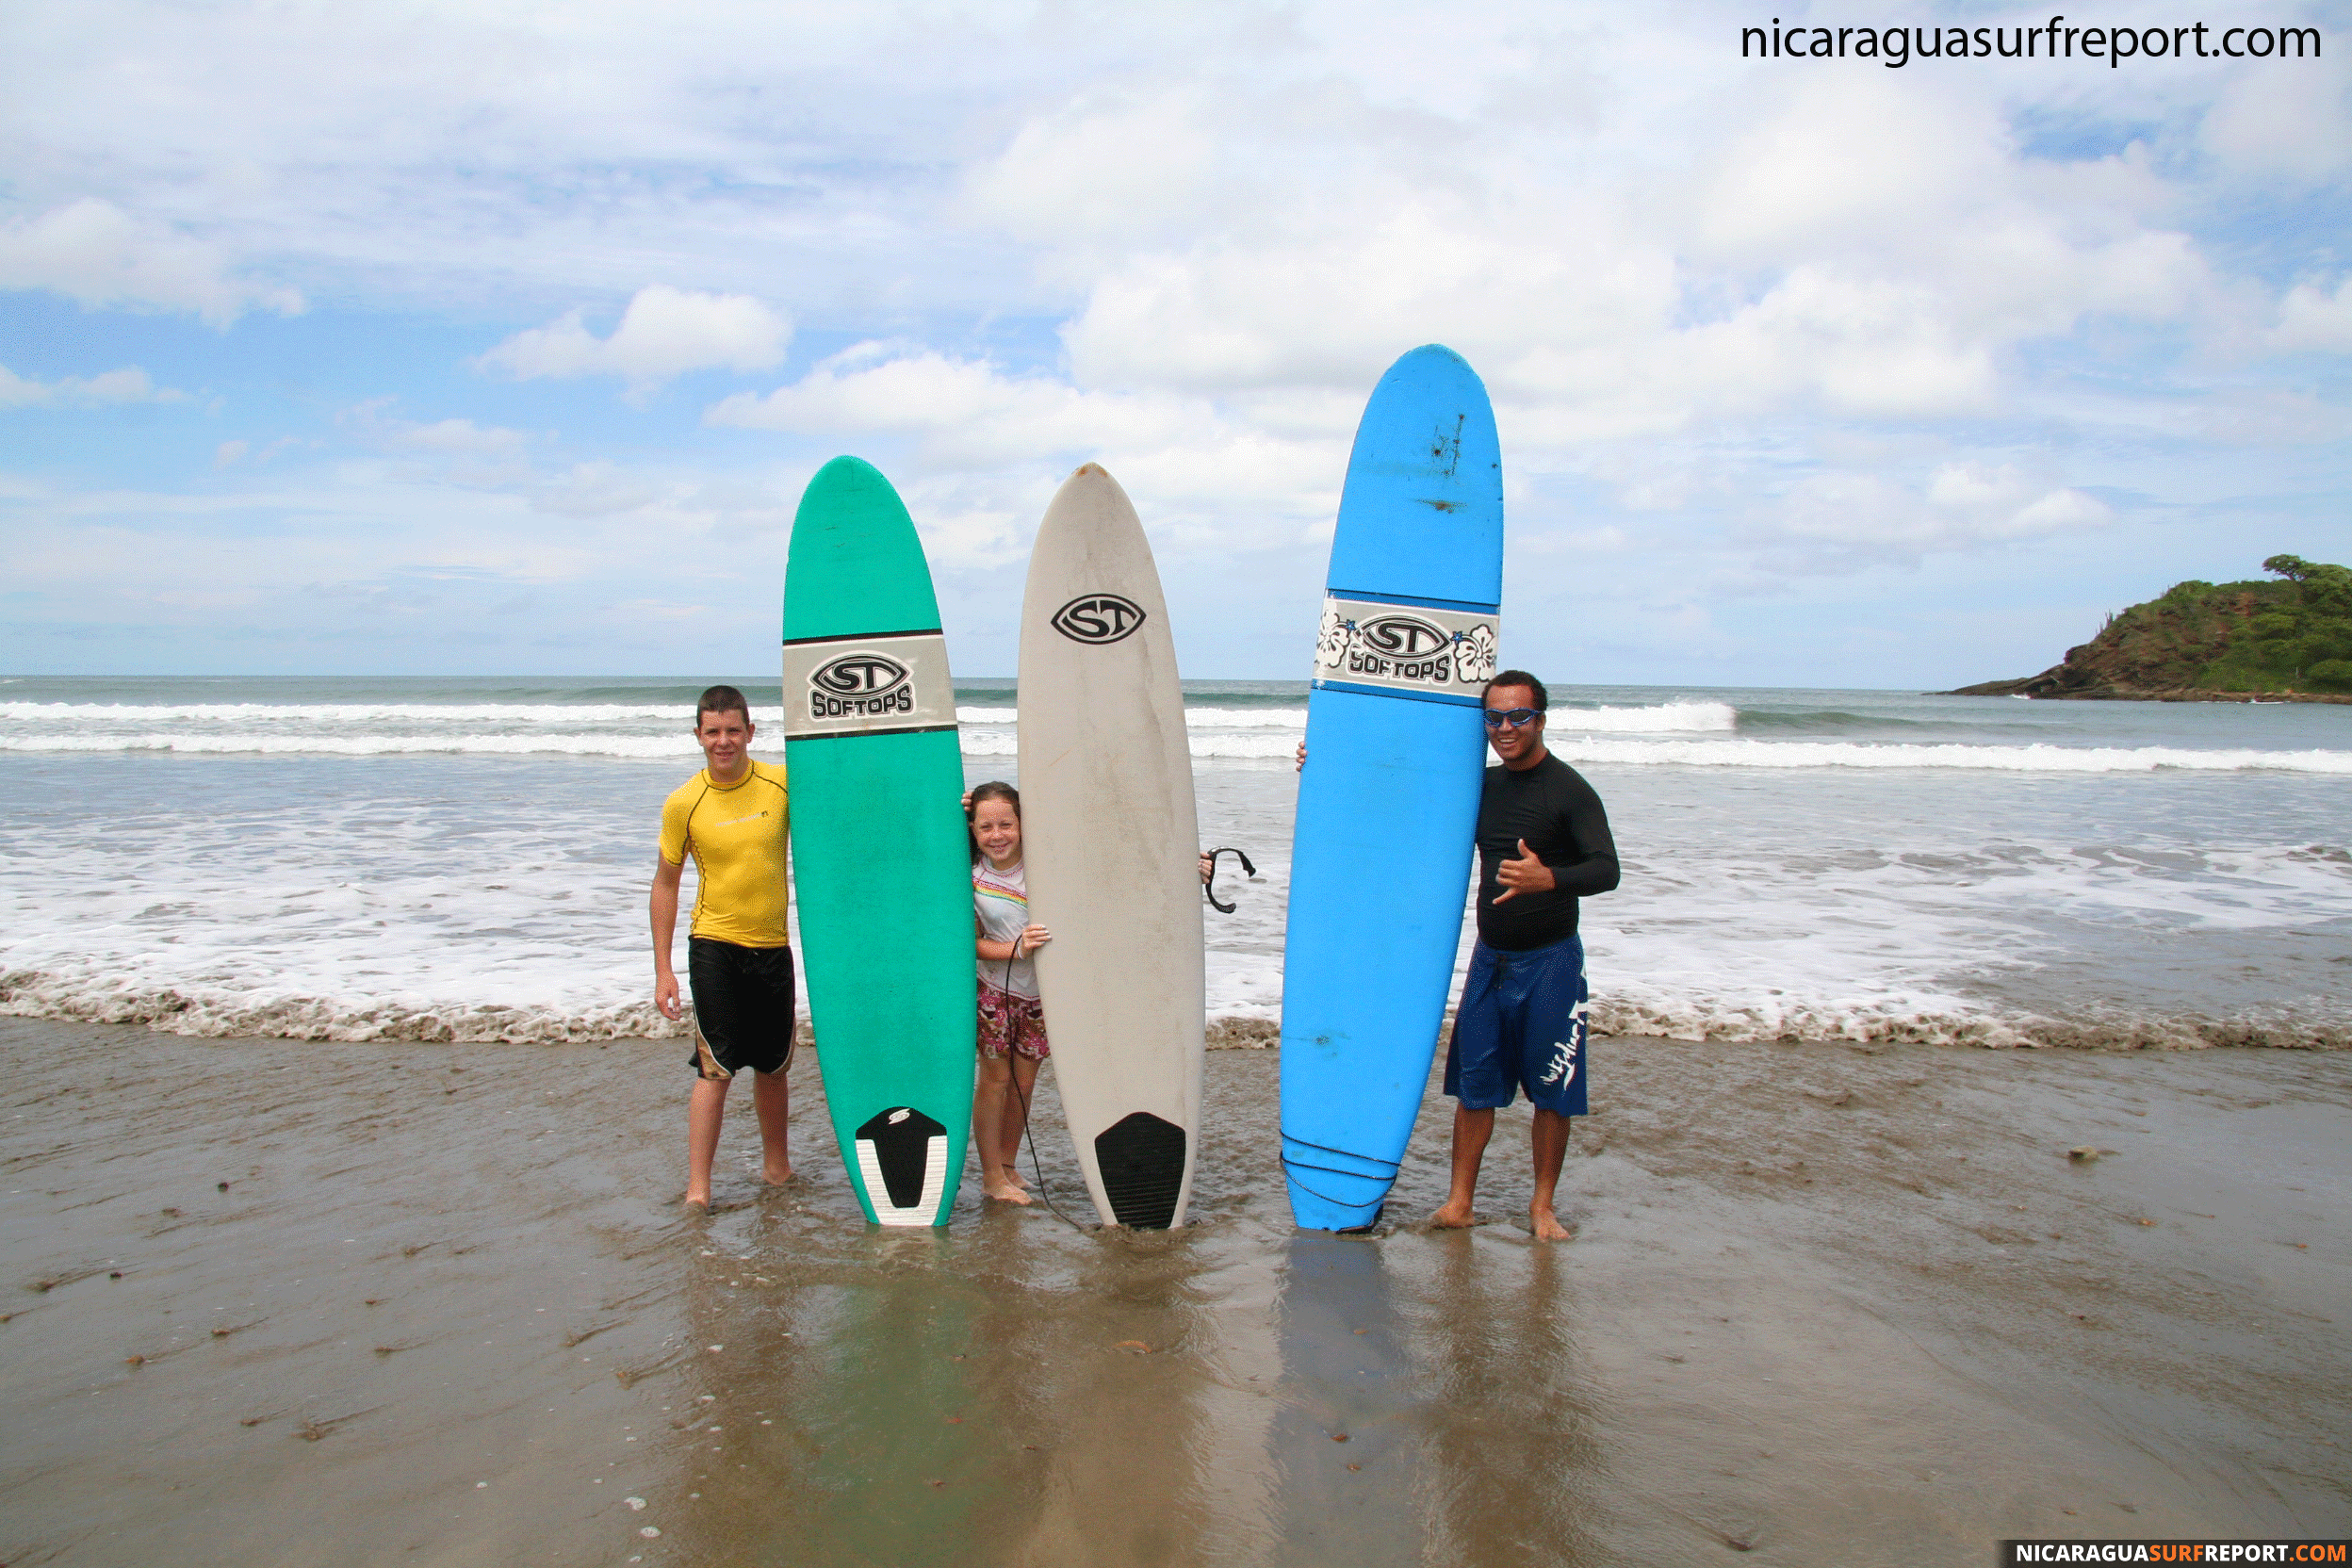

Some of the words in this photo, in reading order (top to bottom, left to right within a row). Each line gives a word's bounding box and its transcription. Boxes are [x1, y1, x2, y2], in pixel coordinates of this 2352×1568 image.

[1061, 599, 1137, 638] ST
[1363, 621, 1444, 654] ST
[821, 661, 899, 691] ST
[1348, 648, 1452, 682] SOFTOPS
[810, 683, 912, 719] SOFTOPS
